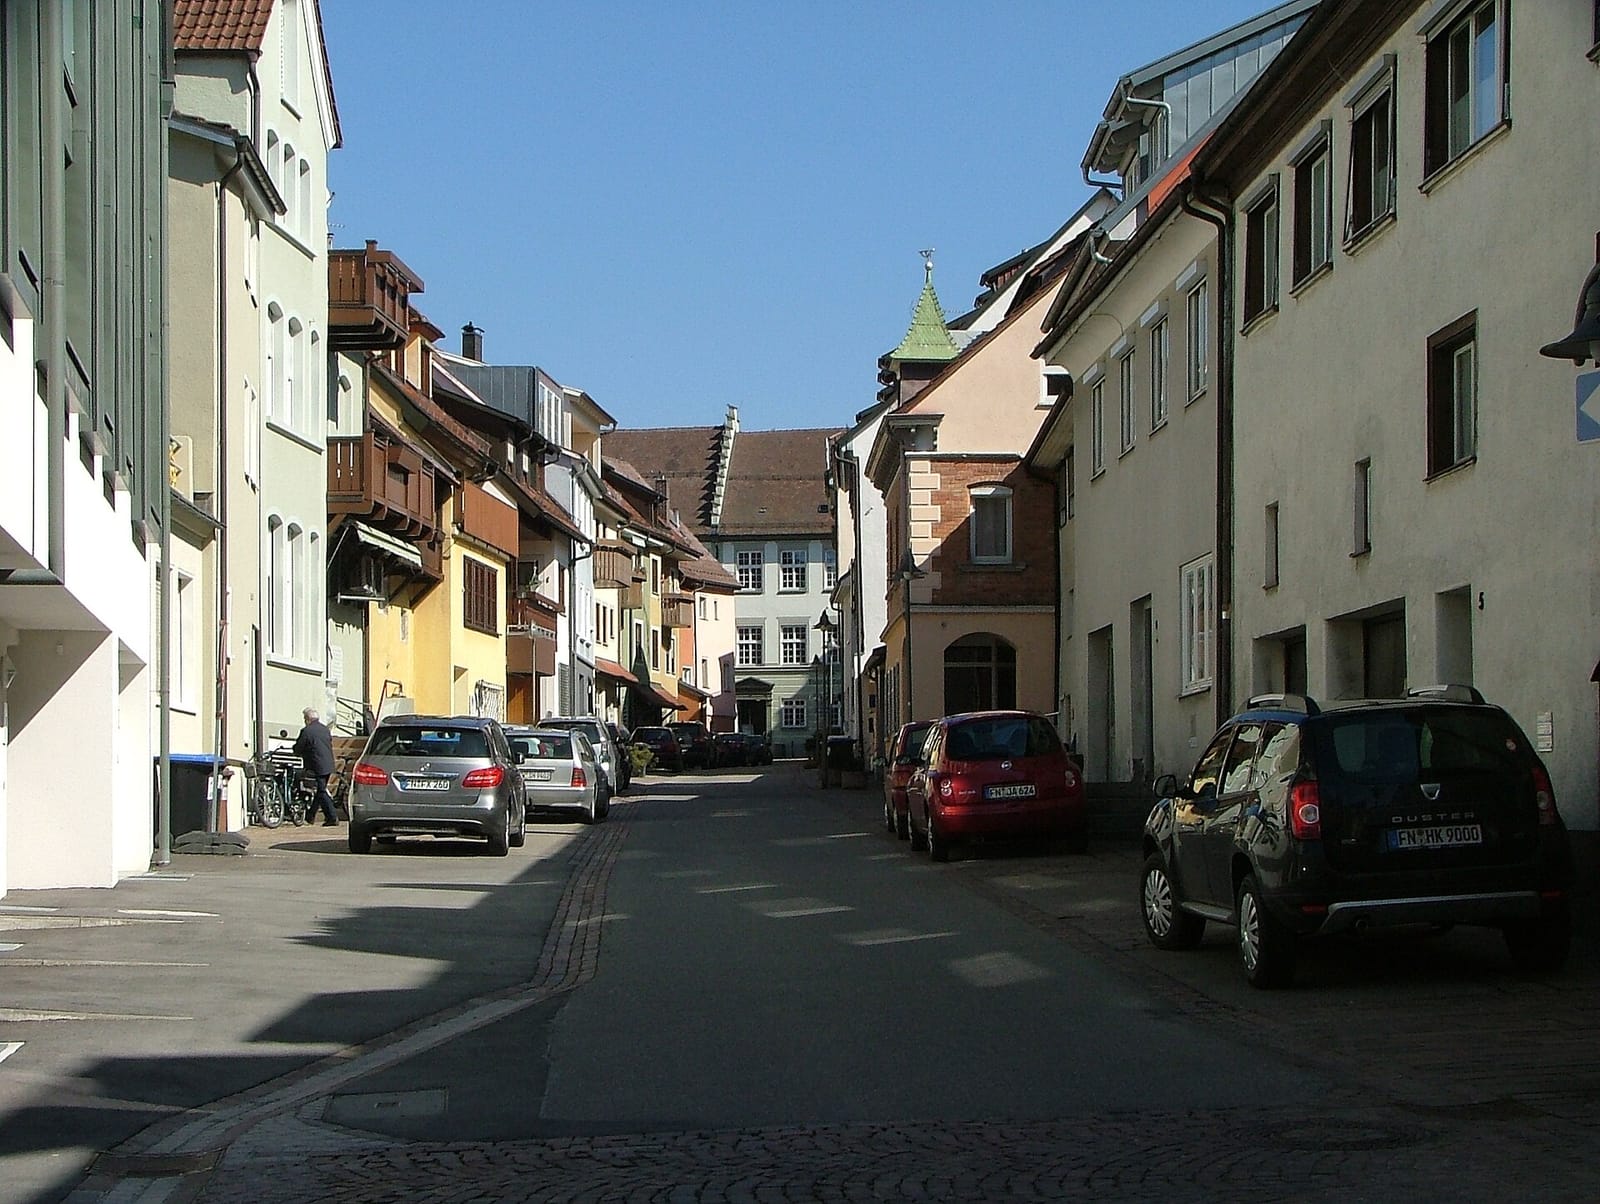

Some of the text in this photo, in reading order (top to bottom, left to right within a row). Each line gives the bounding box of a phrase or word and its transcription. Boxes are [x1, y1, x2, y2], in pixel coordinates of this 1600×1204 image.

[989, 787, 1001, 797] FN
[1019, 786, 1034, 795] 624
[1391, 812, 1474, 823] DUSTER
[1398, 827, 1479, 845] FN HK 9000
